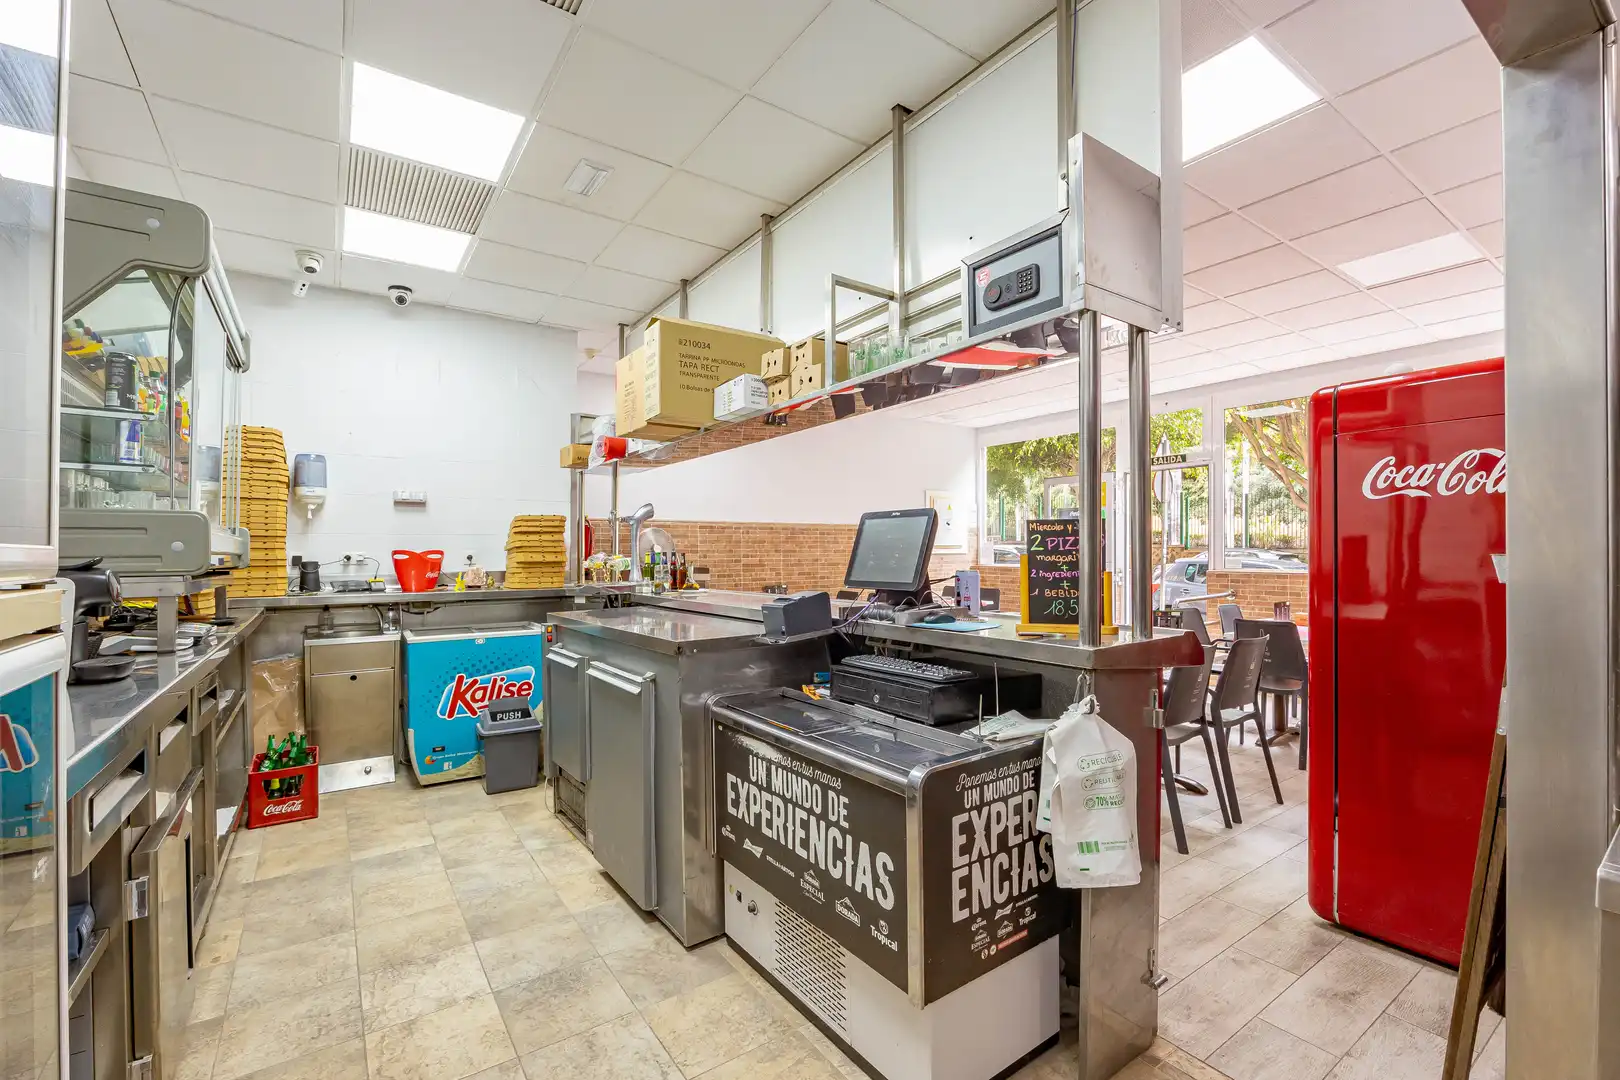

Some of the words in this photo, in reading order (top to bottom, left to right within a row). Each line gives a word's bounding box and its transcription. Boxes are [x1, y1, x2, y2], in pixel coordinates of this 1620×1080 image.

[679, 360, 698, 370] TAPA
[701, 364, 720, 373] RECT
[679, 370, 720, 382] TRANSPARENTE
[1153, 455, 1183, 465] SALIDA
[1030, 534, 1045, 551] 2
[1030, 569, 1037, 578] 2
[446, 673, 534, 720] Kalise
[496, 711, 522, 721] PUSH
[813, 769, 842, 790] manos
[956, 769, 997, 791] Ponemos
[964, 786, 981, 809] UN
[983, 774, 1020, 803] MUNDO
[1022, 769, 1036, 790] DE
[748, 754, 768, 788] UN
[770, 764, 822, 816] MUNDO
[828, 789, 849, 829] DE
[263, 799, 305, 817] Coca-Cola
[726, 772, 895, 911] EXPERIENCIAS
[951, 833, 1055, 923] ENCIAS
[837, 904, 859, 925] DORADA
[1019, 911, 1037, 926] Tropical
[870, 924, 898, 952] Tropical
